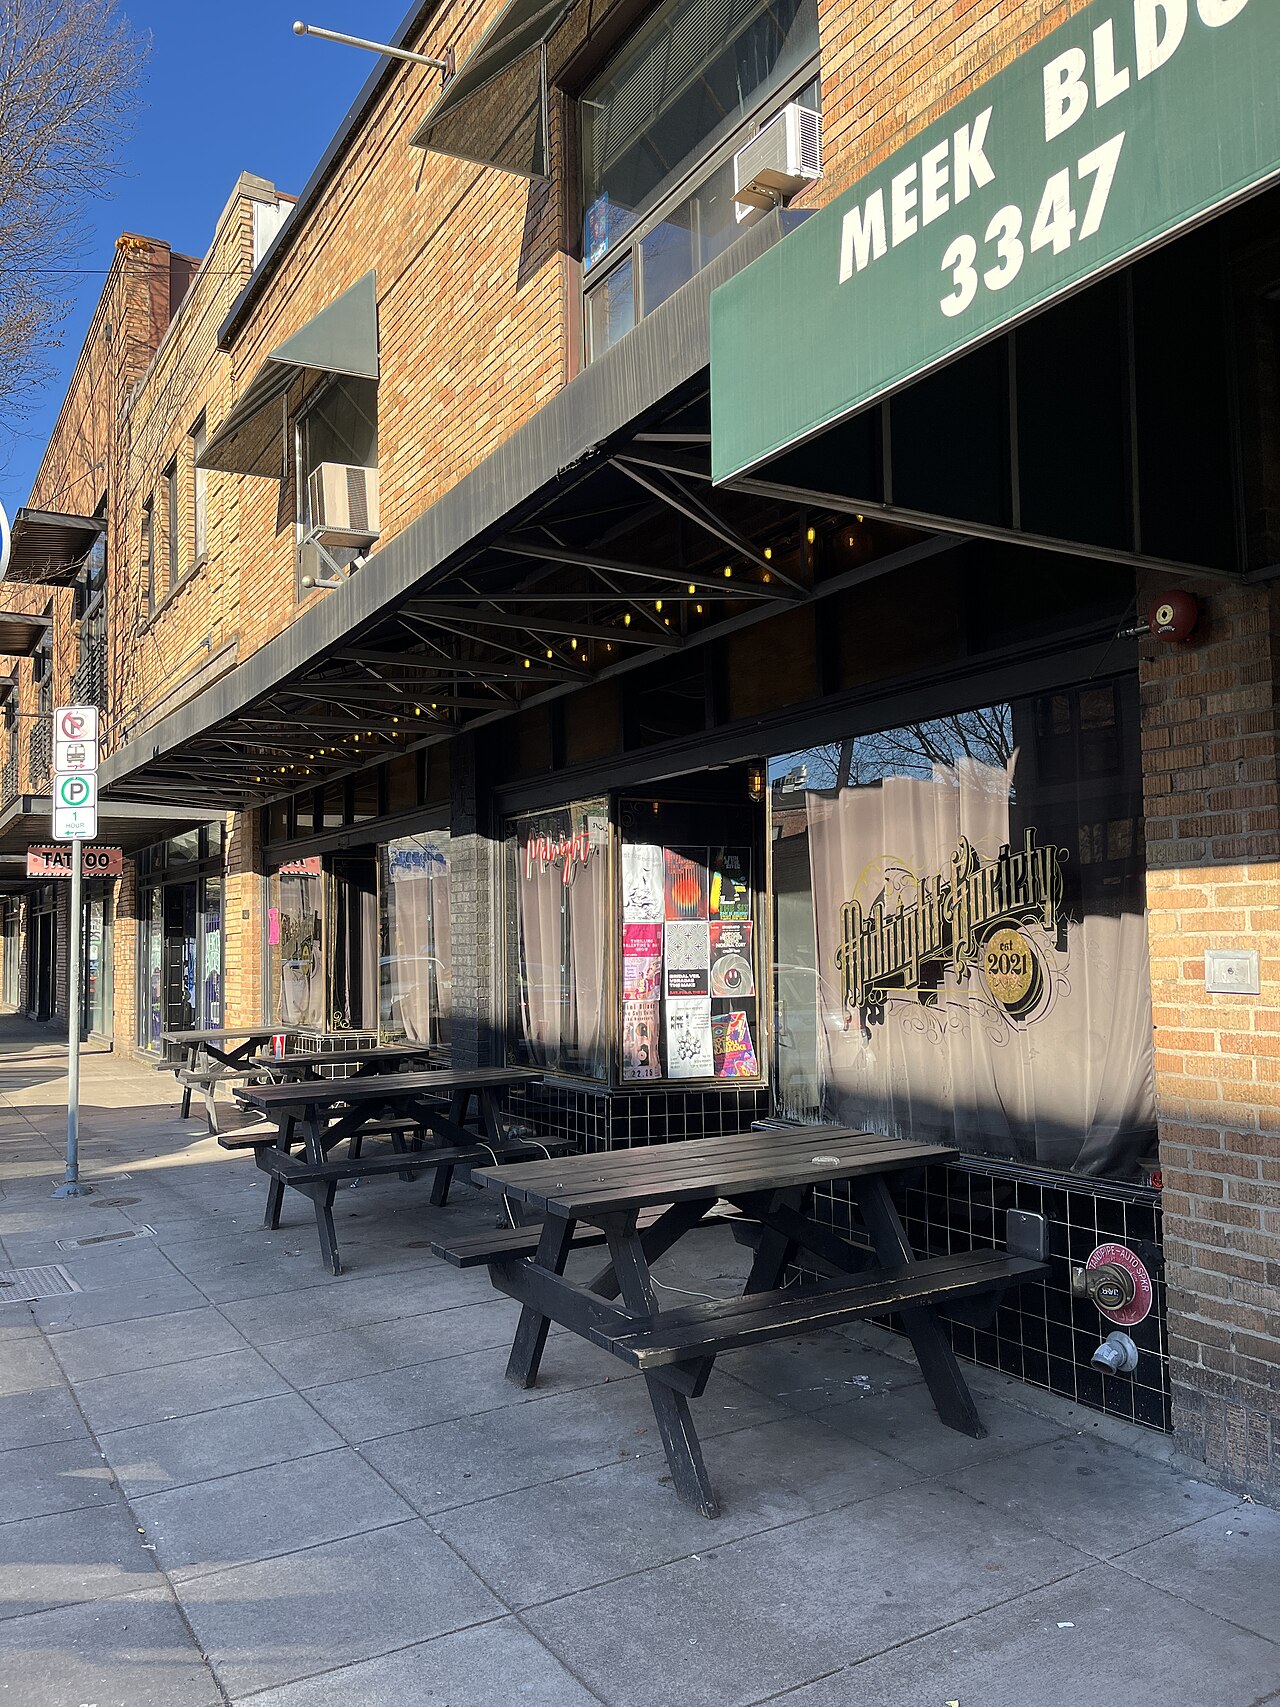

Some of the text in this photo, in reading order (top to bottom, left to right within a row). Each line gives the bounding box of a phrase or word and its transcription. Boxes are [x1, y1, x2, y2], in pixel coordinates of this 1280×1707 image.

[839, 105, 996, 285] MEEK
[940, 131, 1126, 318] 3347
[72, 811, 78, 821] 1
[41, 851, 110, 869] TATOO
[835, 827, 1060, 1008] Midnight Society
[1000, 940, 1013, 951] est
[988, 953, 1028, 976] 2021
[1136, 1267, 1150, 1292] SPKR
